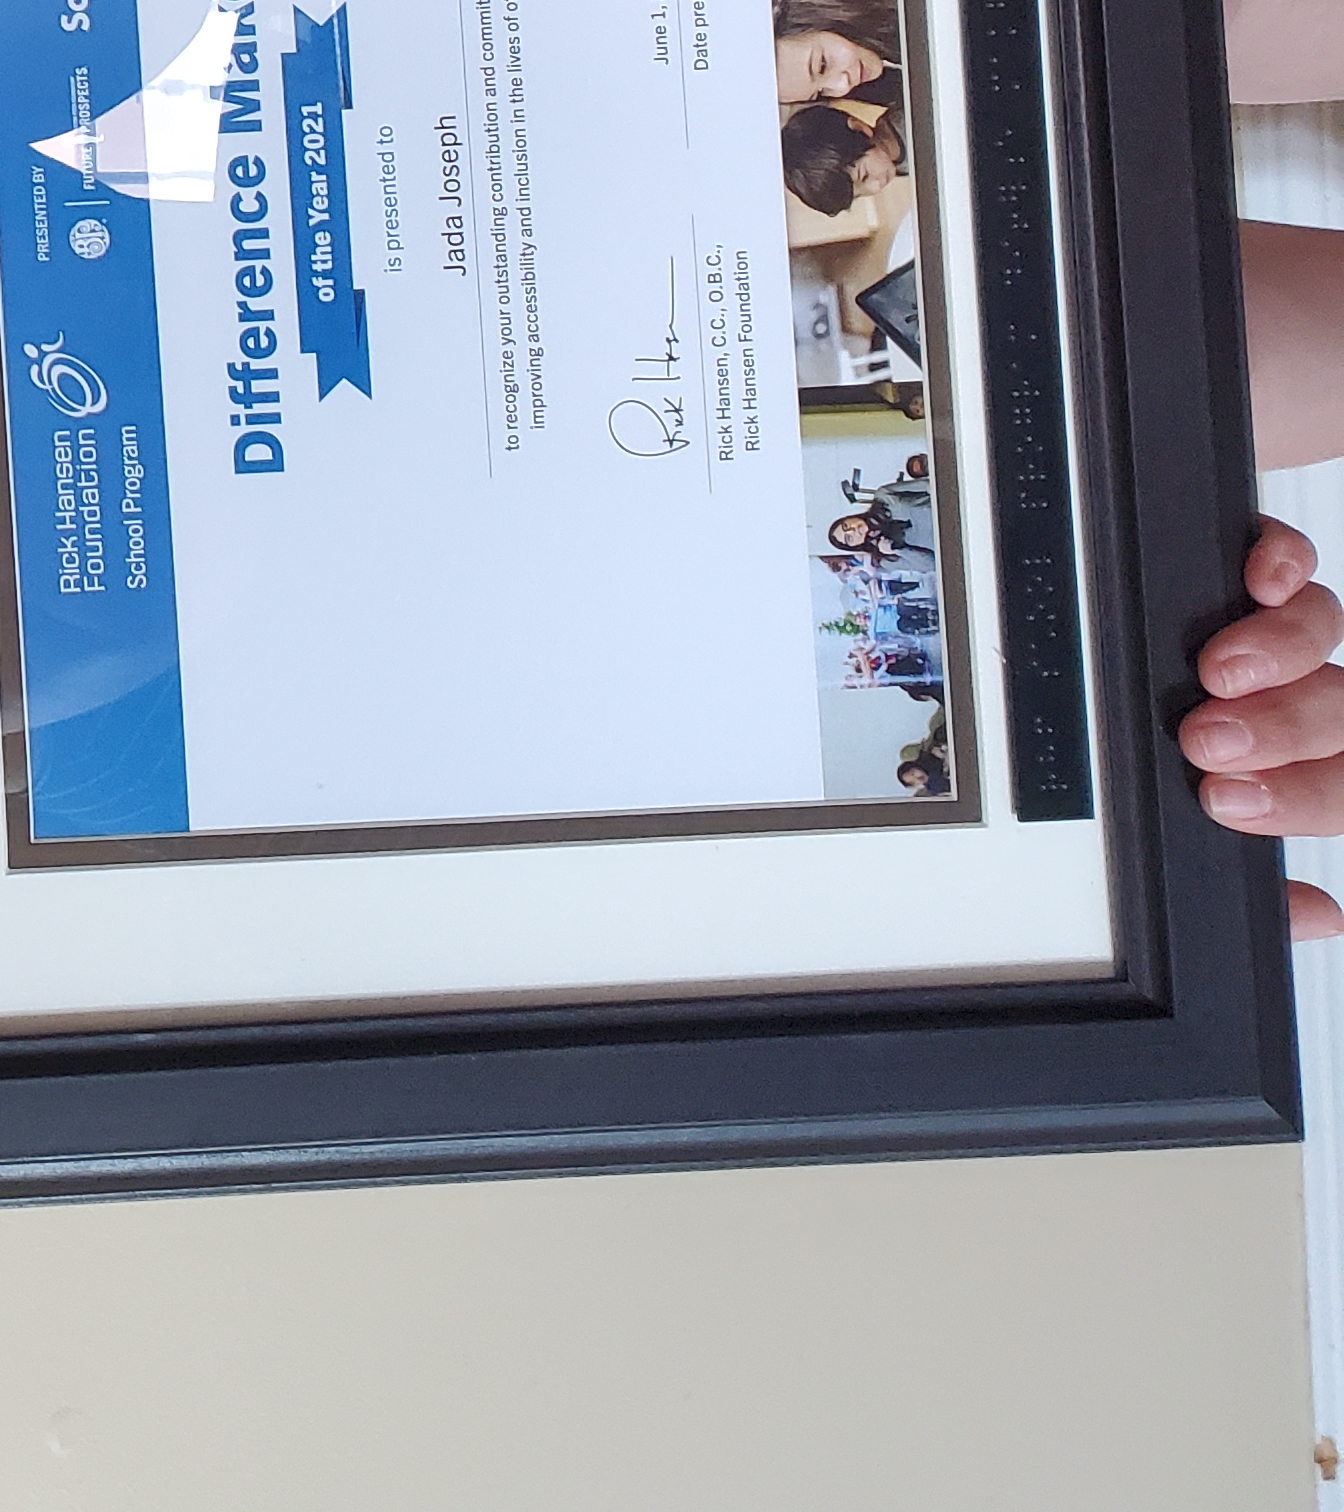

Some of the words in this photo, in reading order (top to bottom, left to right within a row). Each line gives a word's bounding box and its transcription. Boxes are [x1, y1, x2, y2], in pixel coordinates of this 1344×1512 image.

[502, 15, 520, 32] of
[650, 5, 668, 20] 1,
[505, 36, 523, 73] lives
[653, 25, 670, 66] June
[692, 32, 709, 71] Date
[75, 65, 92, 132] PROSPECTS
[479, 66, 497, 97] and
[507, 77, 525, 104] the
[299, 99, 328, 168] 2021
[375, 125, 394, 145] to
[509, 108, 526, 123] in
[31, 164, 45, 182] BY
[79, 145, 95, 190] FUTURE
[433, 115, 464, 208] Joseph
[482, 101, 504, 203] contribution
[511, 128, 531, 202] inclusion
[33, 185, 50, 261] PRESENTED
[303, 168, 331, 227] Year
[377, 151, 405, 251] presented
[515, 206, 533, 238] and
[307, 228, 335, 272] the
[383, 256, 403, 273] is
[440, 215, 467, 277] Jada
[489, 206, 511, 305] outstanding
[705, 244, 724, 303] O.B.C.,
[226, 153, 286, 474] Difference
[311, 273, 337, 303] of
[518, 241, 540, 343] accessibility
[733, 250, 754, 343] Foundation
[498, 308, 517, 346] your
[709, 308, 728, 348] C.C.,
[499, 349, 520, 430] recognize
[526, 346, 548, 430] improving
[715, 352, 732, 420] Hansen,
[741, 347, 758, 410] Hansen
[504, 434, 520, 451] to
[716, 424, 735, 461] Rick
[742, 414, 761, 451] Rick
[52, 429, 77, 530] Hansen
[120, 424, 145, 512] Program
[76, 426, 106, 590] Foundation
[58, 535, 81, 592] Rick
[124, 518, 147, 588] School
